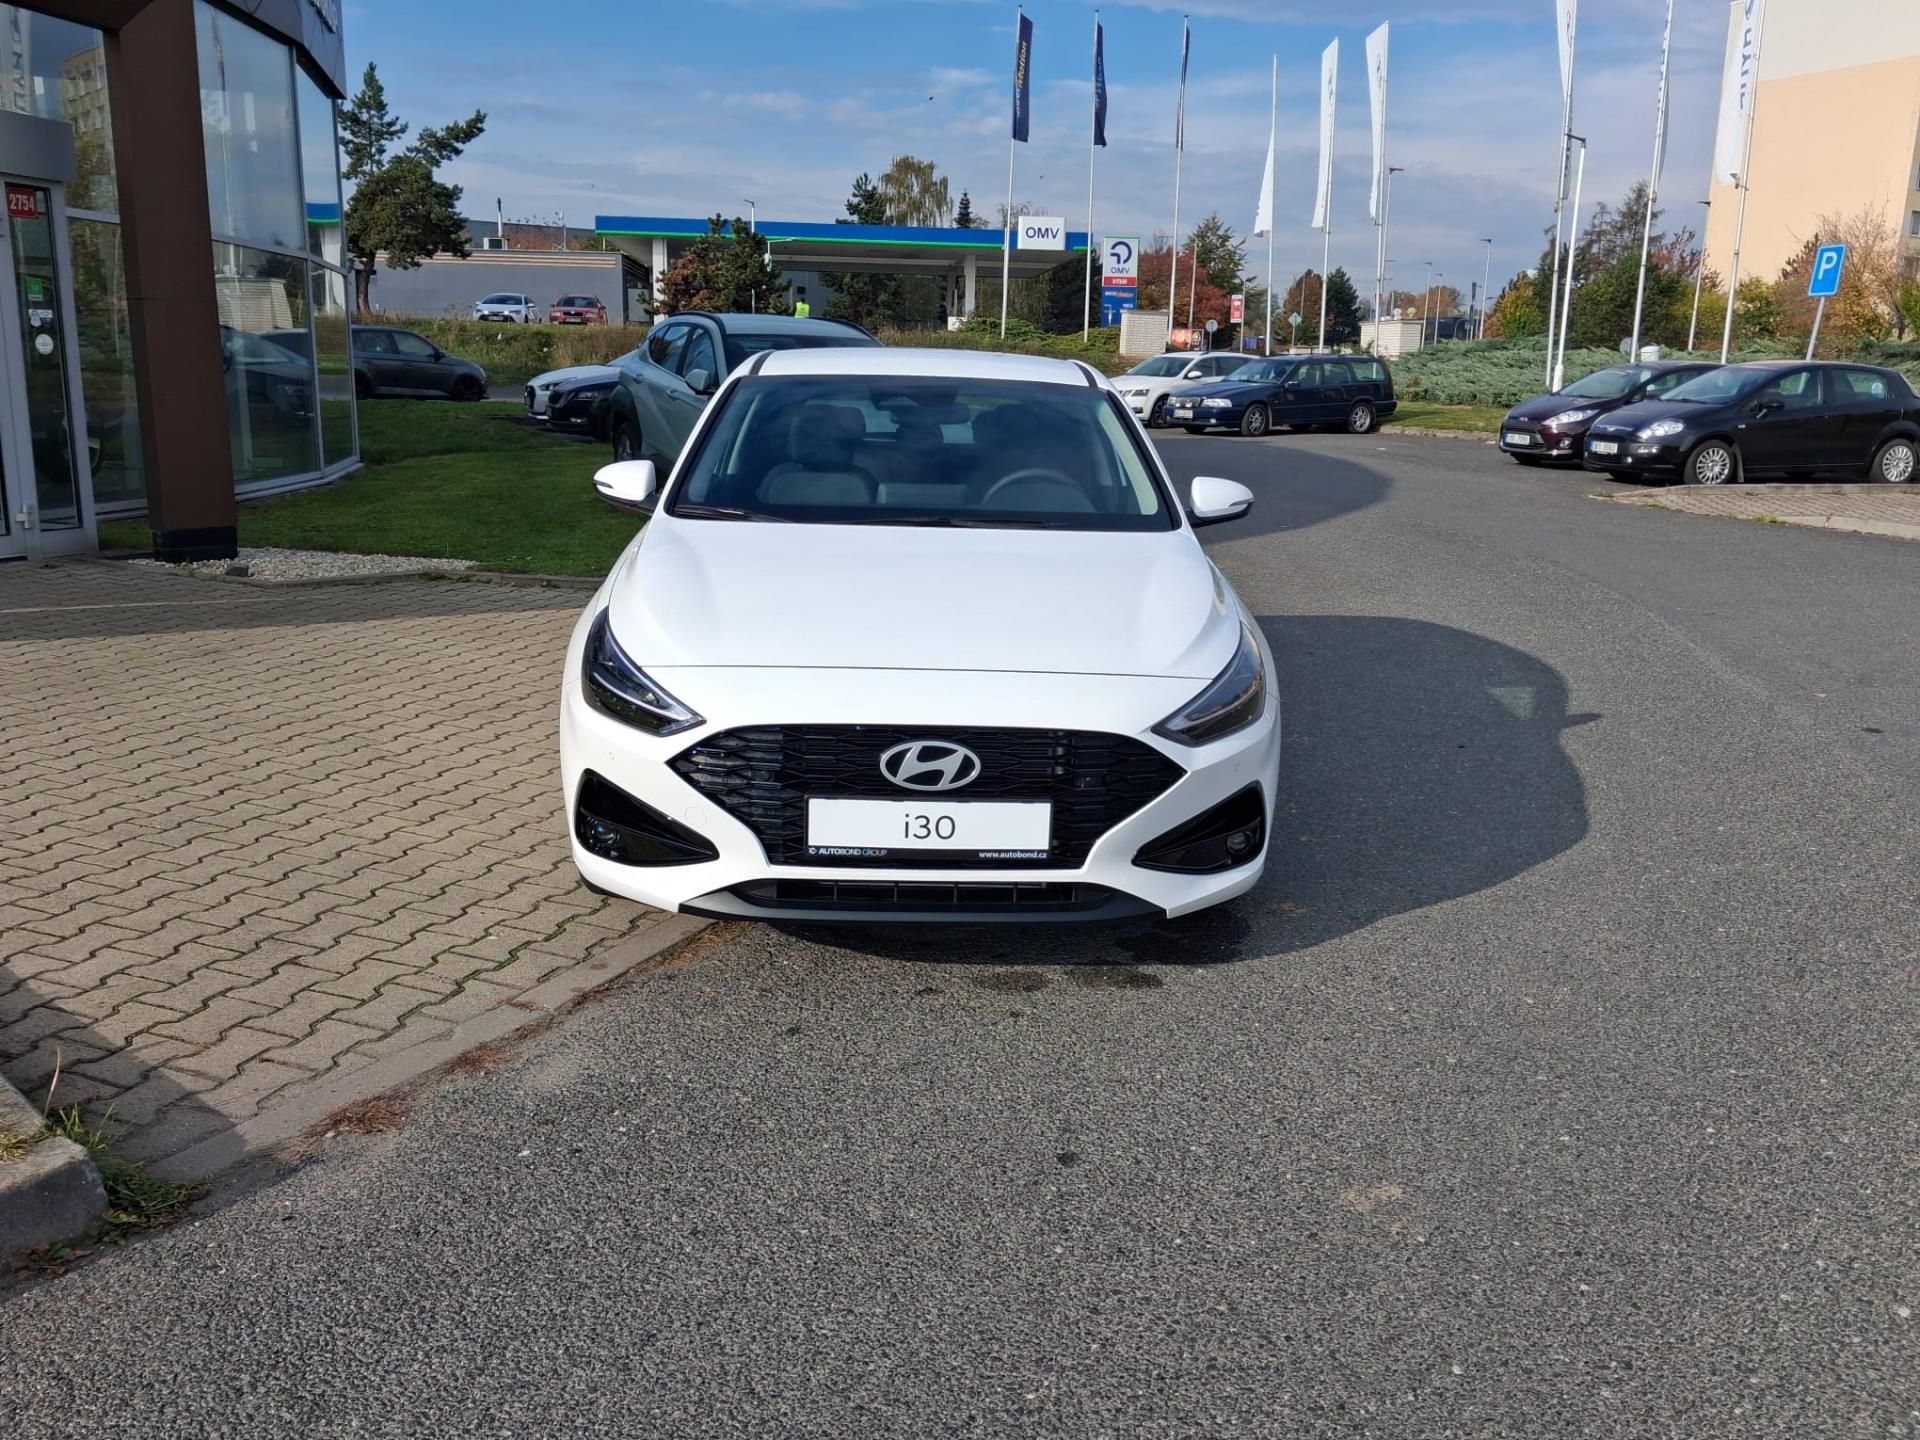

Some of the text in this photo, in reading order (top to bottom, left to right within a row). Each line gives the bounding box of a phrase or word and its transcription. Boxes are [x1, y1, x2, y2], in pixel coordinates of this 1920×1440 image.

[9, 194, 35, 212] 2754
[1025, 226, 1060, 240] OMV
[1110, 266, 1130, 274] OMV
[1818, 251, 1838, 280] P
[904, 813, 956, 840] i30
[818, 848, 887, 857] AUTOBOND GROUP
[979, 851, 1047, 859] www.autobond.cz
